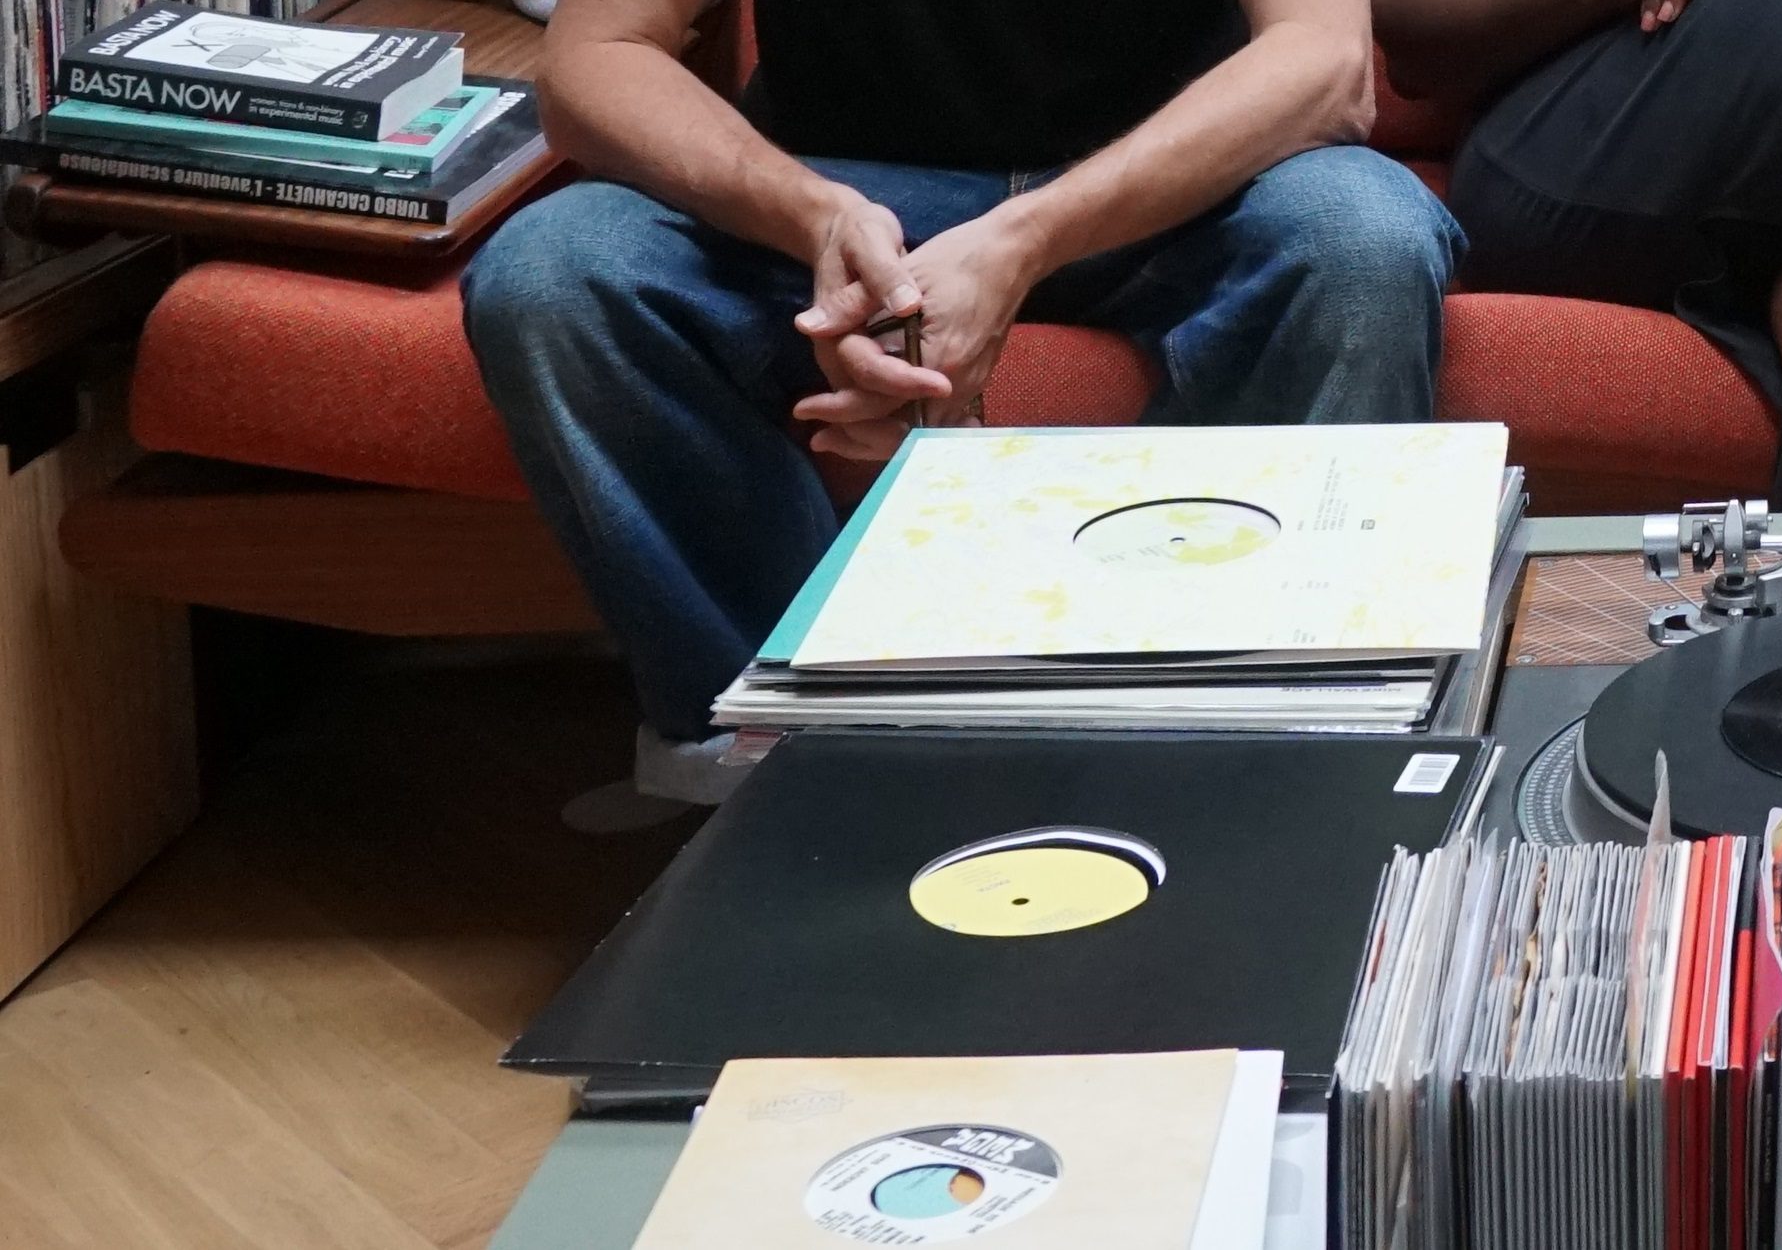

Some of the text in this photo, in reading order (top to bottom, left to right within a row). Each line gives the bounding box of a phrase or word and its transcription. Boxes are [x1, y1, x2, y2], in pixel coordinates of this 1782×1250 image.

[88, 9, 181, 56] BASTA NOW
[70, 67, 242, 115] BASTA NOW
[59, 152, 170, 182] scandaleuse
[173, 167, 263, 197] L'aventure
[375, 196, 429, 220] TURBO
